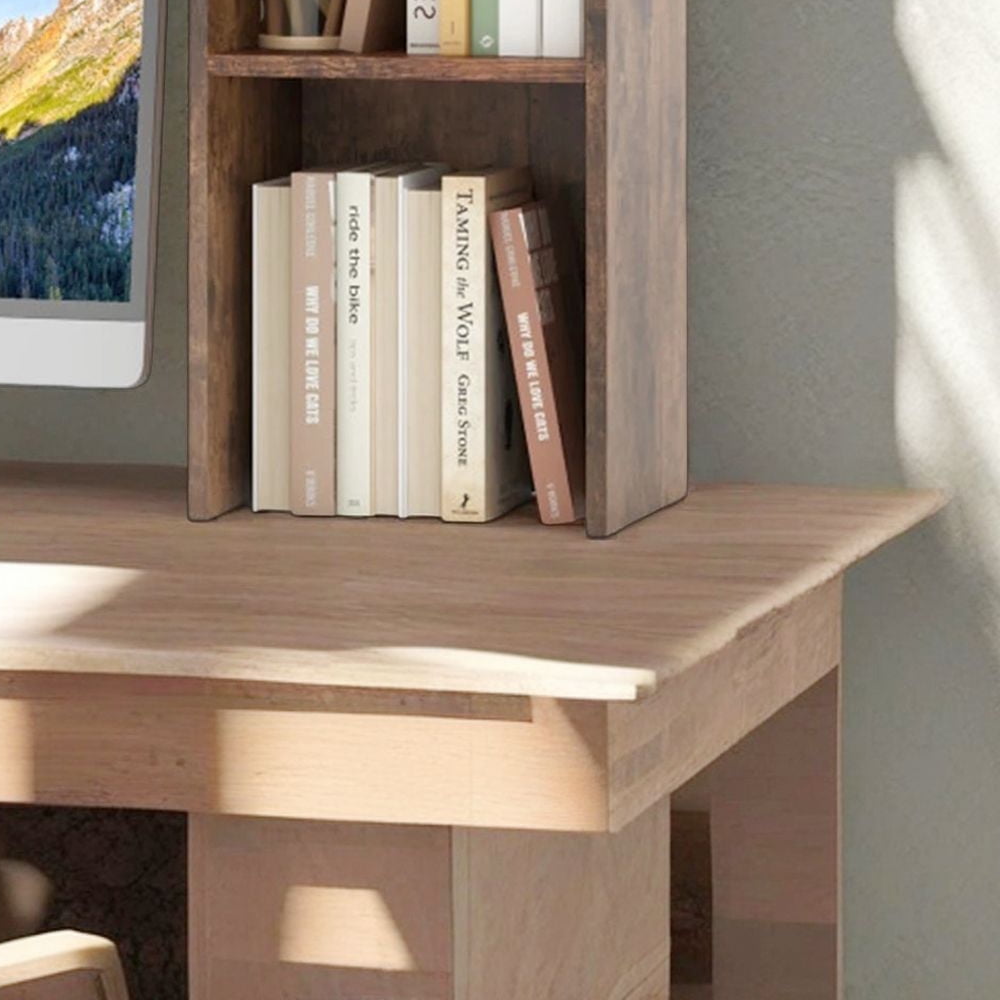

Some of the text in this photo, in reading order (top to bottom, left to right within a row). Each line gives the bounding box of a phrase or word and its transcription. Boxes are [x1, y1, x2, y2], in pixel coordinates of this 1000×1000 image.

[348, 205, 360, 242] ride
[348, 248, 360, 279] the
[348, 284, 360, 324] bike
[456, 189, 473, 467] TAMING the WOLF GREG STONE
[305, 285, 319, 424] WHY DO WE LOVE CATS
[517, 312, 550, 442] WHY DO WE LOVE CATS
